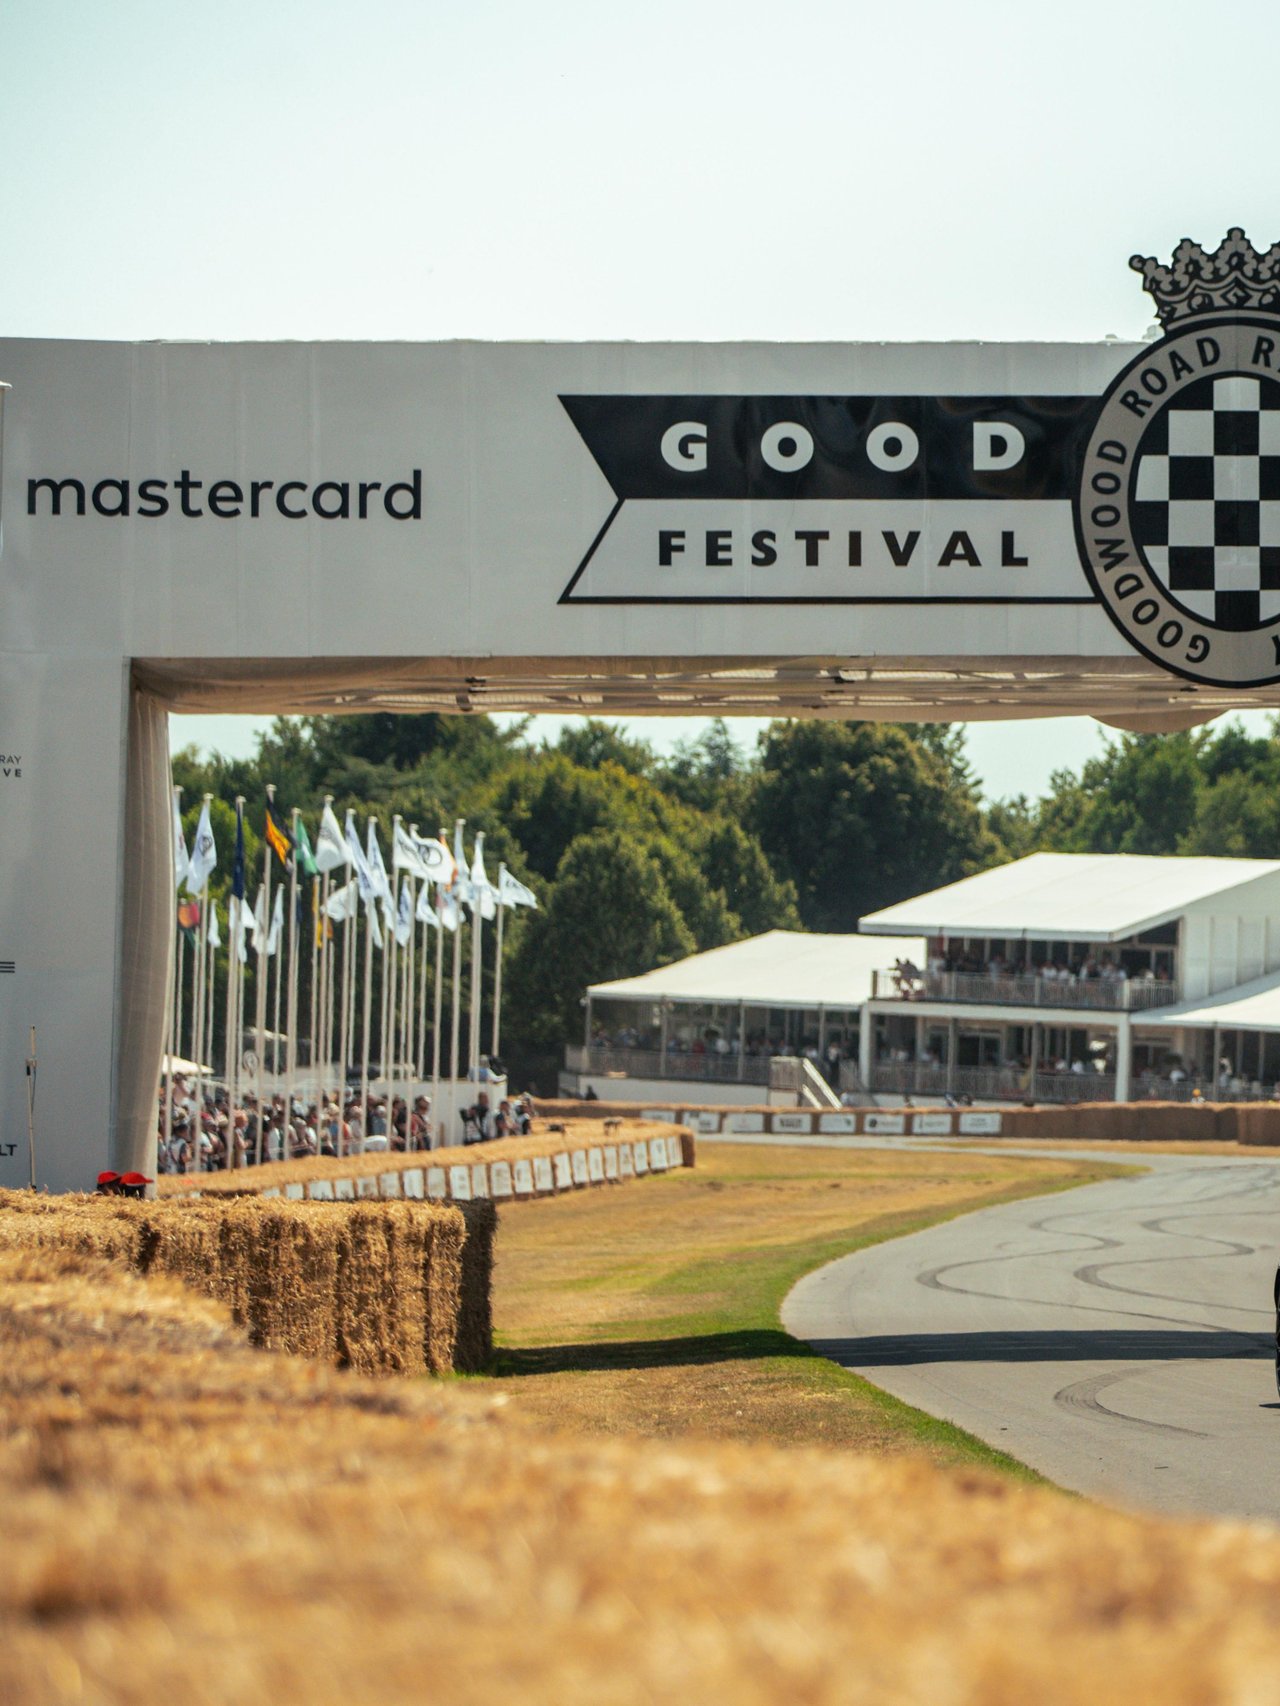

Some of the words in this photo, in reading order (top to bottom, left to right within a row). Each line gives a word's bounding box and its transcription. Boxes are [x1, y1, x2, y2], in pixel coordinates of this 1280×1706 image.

[1119, 336, 1221, 418] ROAD
[660, 421, 1025, 473] GOOD
[27, 469, 422, 520] mastercard
[658, 530, 1028, 567] FESTIVAL
[1091, 440, 1210, 663] GOODWOOD
